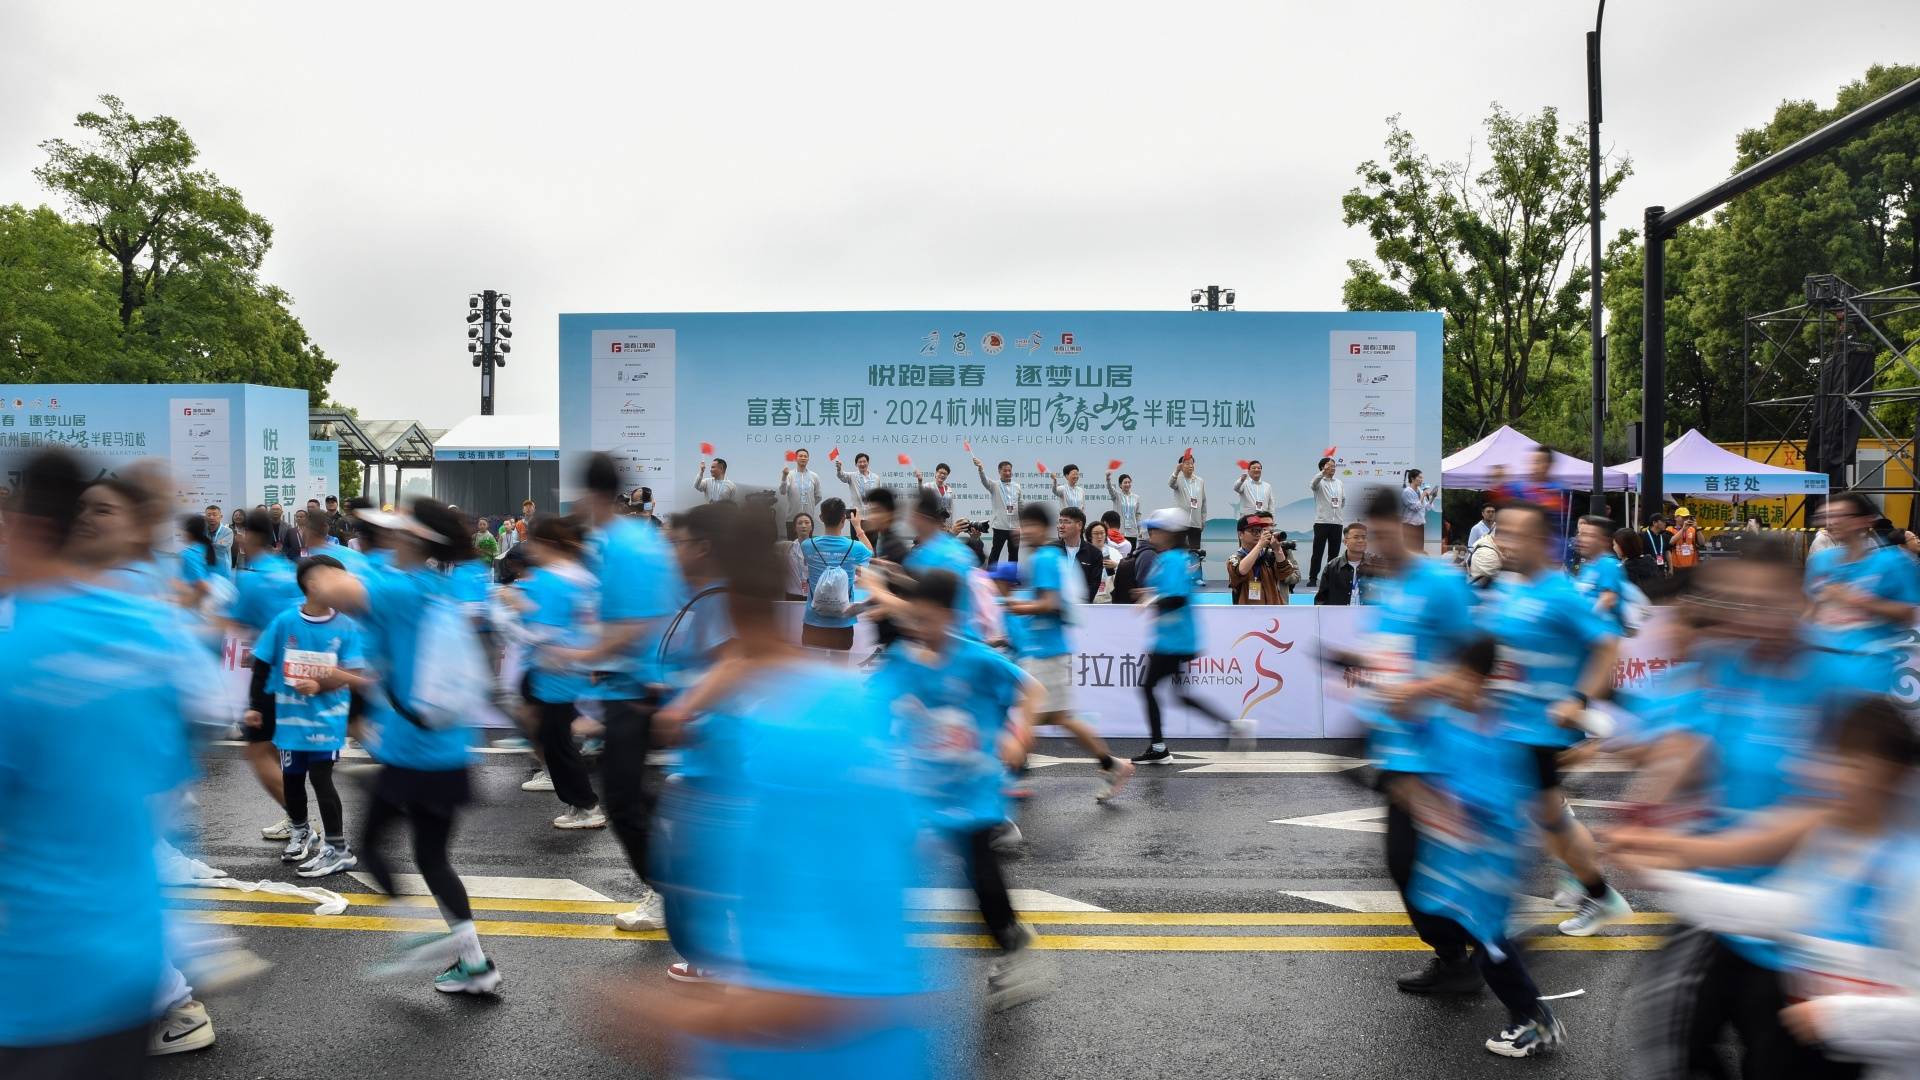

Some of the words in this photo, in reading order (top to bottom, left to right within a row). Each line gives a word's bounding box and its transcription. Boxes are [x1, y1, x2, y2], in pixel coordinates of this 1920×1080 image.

[868, 364, 986, 388] 悦跑富春
[1015, 364, 1133, 388] 逐梦山居
[29, 414, 86, 427] 逐梦山居
[746, 434, 768, 444] FCJ
[775, 434, 821, 444] GROUP
[835, 434, 866, 444] 2024
[872, 434, 949, 444] HANGZHOU
[1080, 435, 1134, 446] RESORT
[1140, 435, 1175, 446] HALF
[1181, 435, 1257, 446] MARATHON
[457, 450, 506, 459] 现场指挥部
[1705, 475, 1761, 492] 音控处
[1066, 653, 1156, 687] 拉松
[1171, 675, 1244, 686] MARATHON
